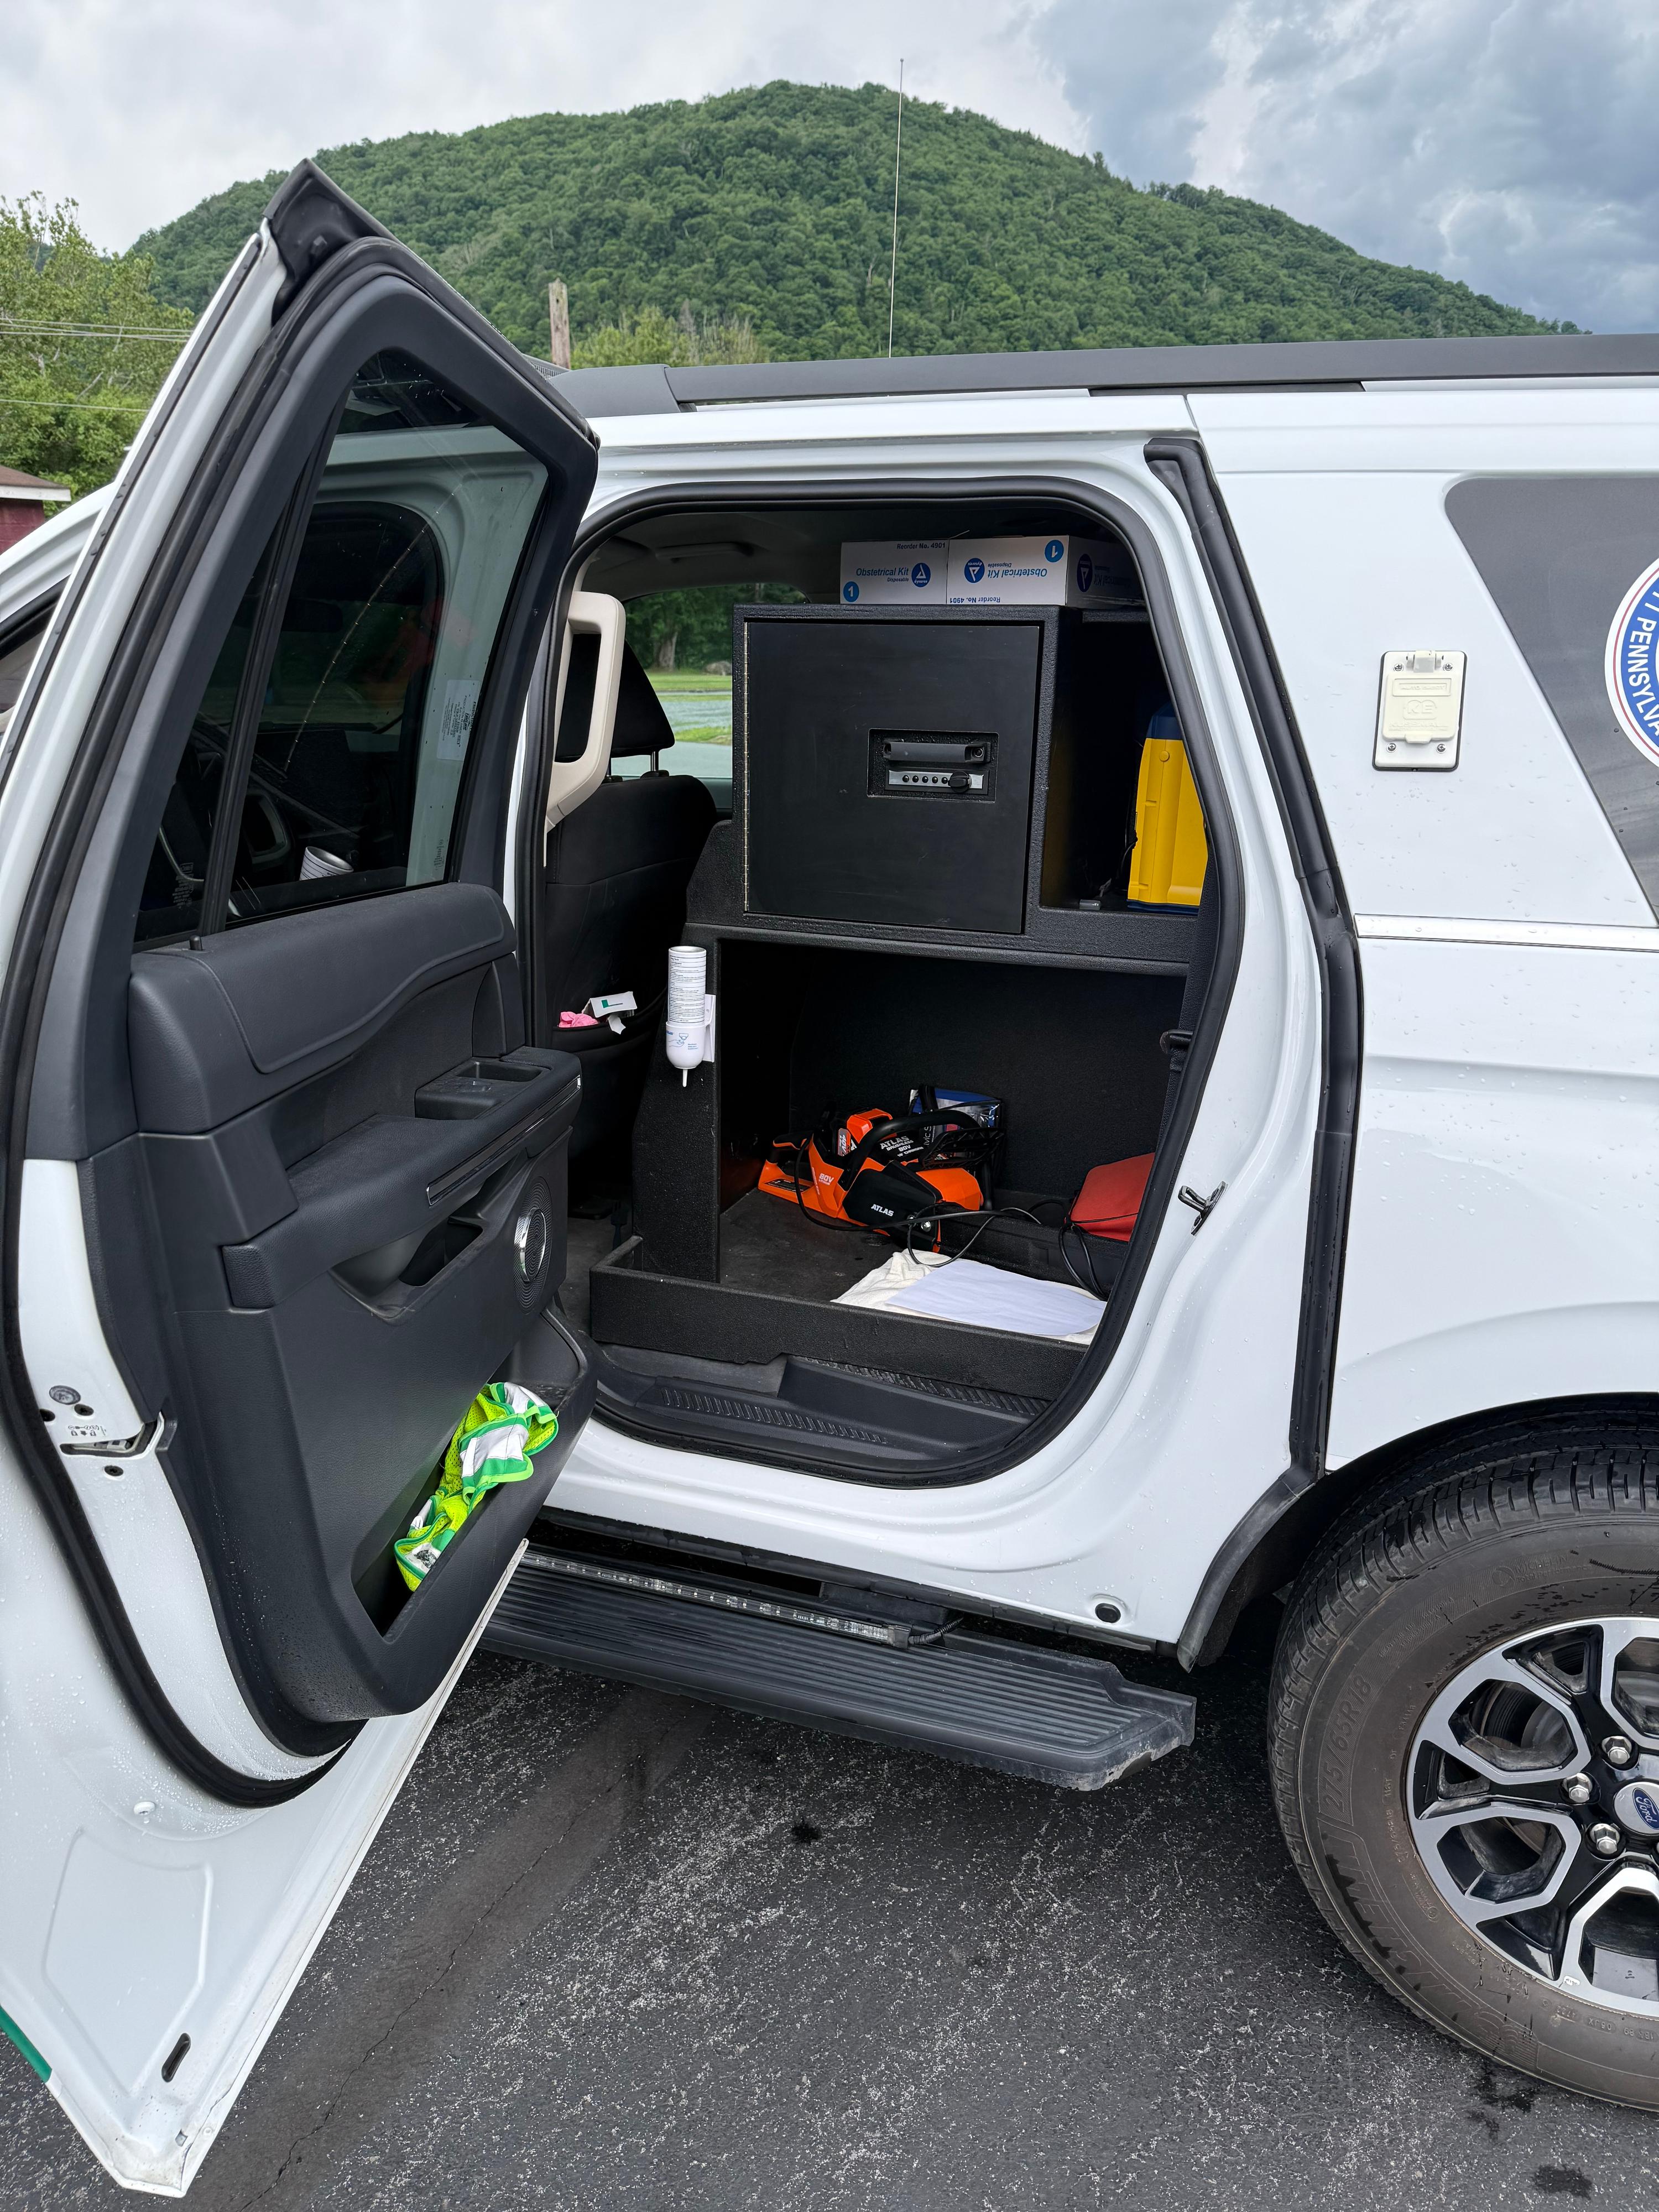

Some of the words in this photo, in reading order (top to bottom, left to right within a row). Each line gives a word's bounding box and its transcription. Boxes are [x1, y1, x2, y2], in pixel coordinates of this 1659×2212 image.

[1051, 545, 1058, 558] 1
[856, 567, 896, 576] Obstetrical
[898, 567, 909, 576] Kit
[988, 570, 1000, 578] Kit
[1001, 568, 1047, 578] Obstetrical
[848, 586, 853, 597] 1
[1628, 617, 1659, 737] PENNSYLVA
[880, 1136, 910, 1150] ATLAS
[886, 1140, 914, 1151] BRUSHLESS
[818, 1172, 834, 1183] 80V
[870, 1203, 894, 1217] ATLAS
[1324, 1675, 1373, 1813] 275/65R18
[1635, 1796, 1658, 1823] Ford
